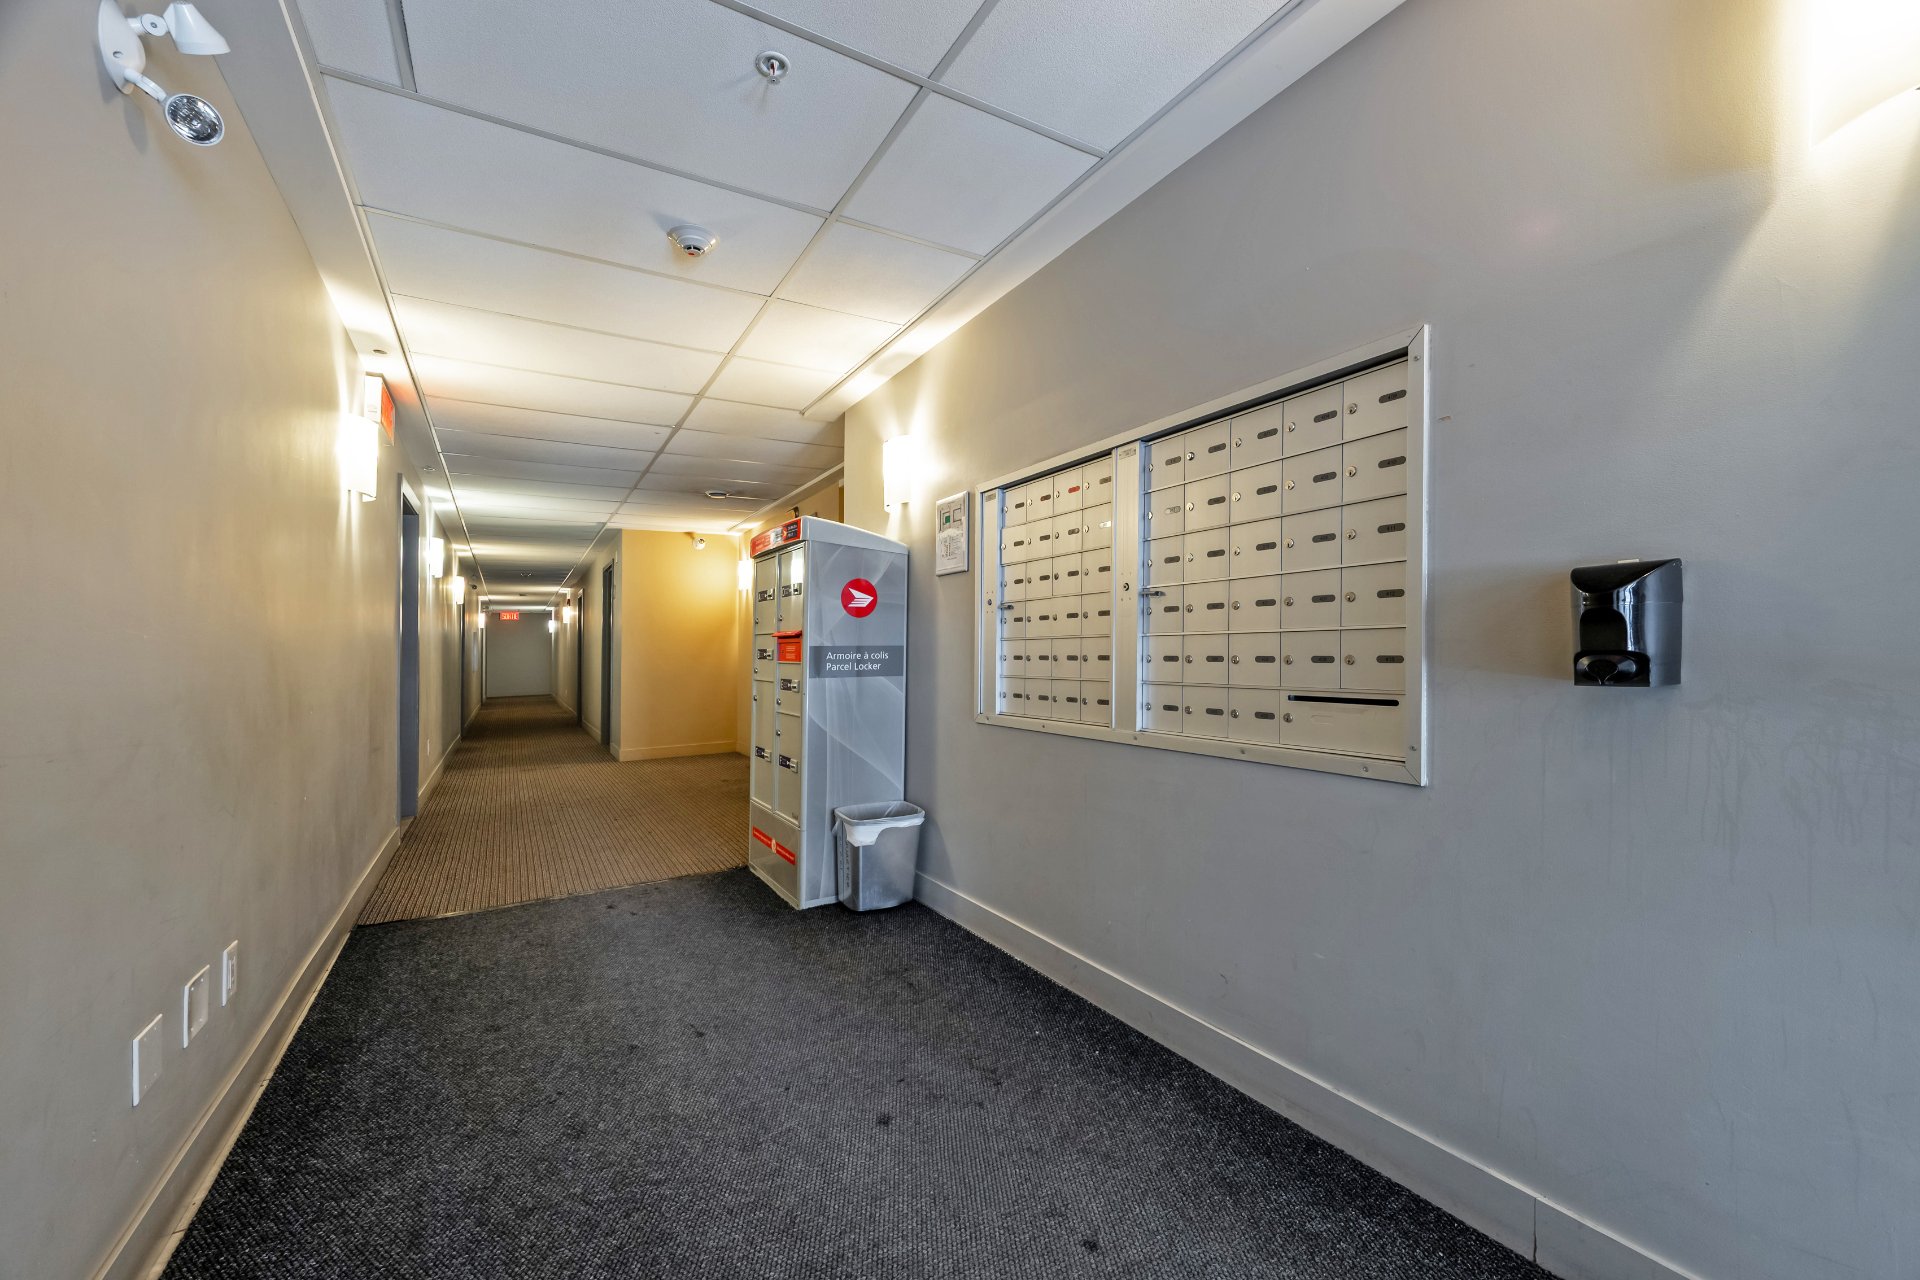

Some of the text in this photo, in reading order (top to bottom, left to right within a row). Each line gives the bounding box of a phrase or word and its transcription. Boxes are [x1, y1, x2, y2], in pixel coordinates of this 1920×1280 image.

[826, 651, 889, 660] Armoire à colis
[826, 662, 882, 671] Parcel Locker
